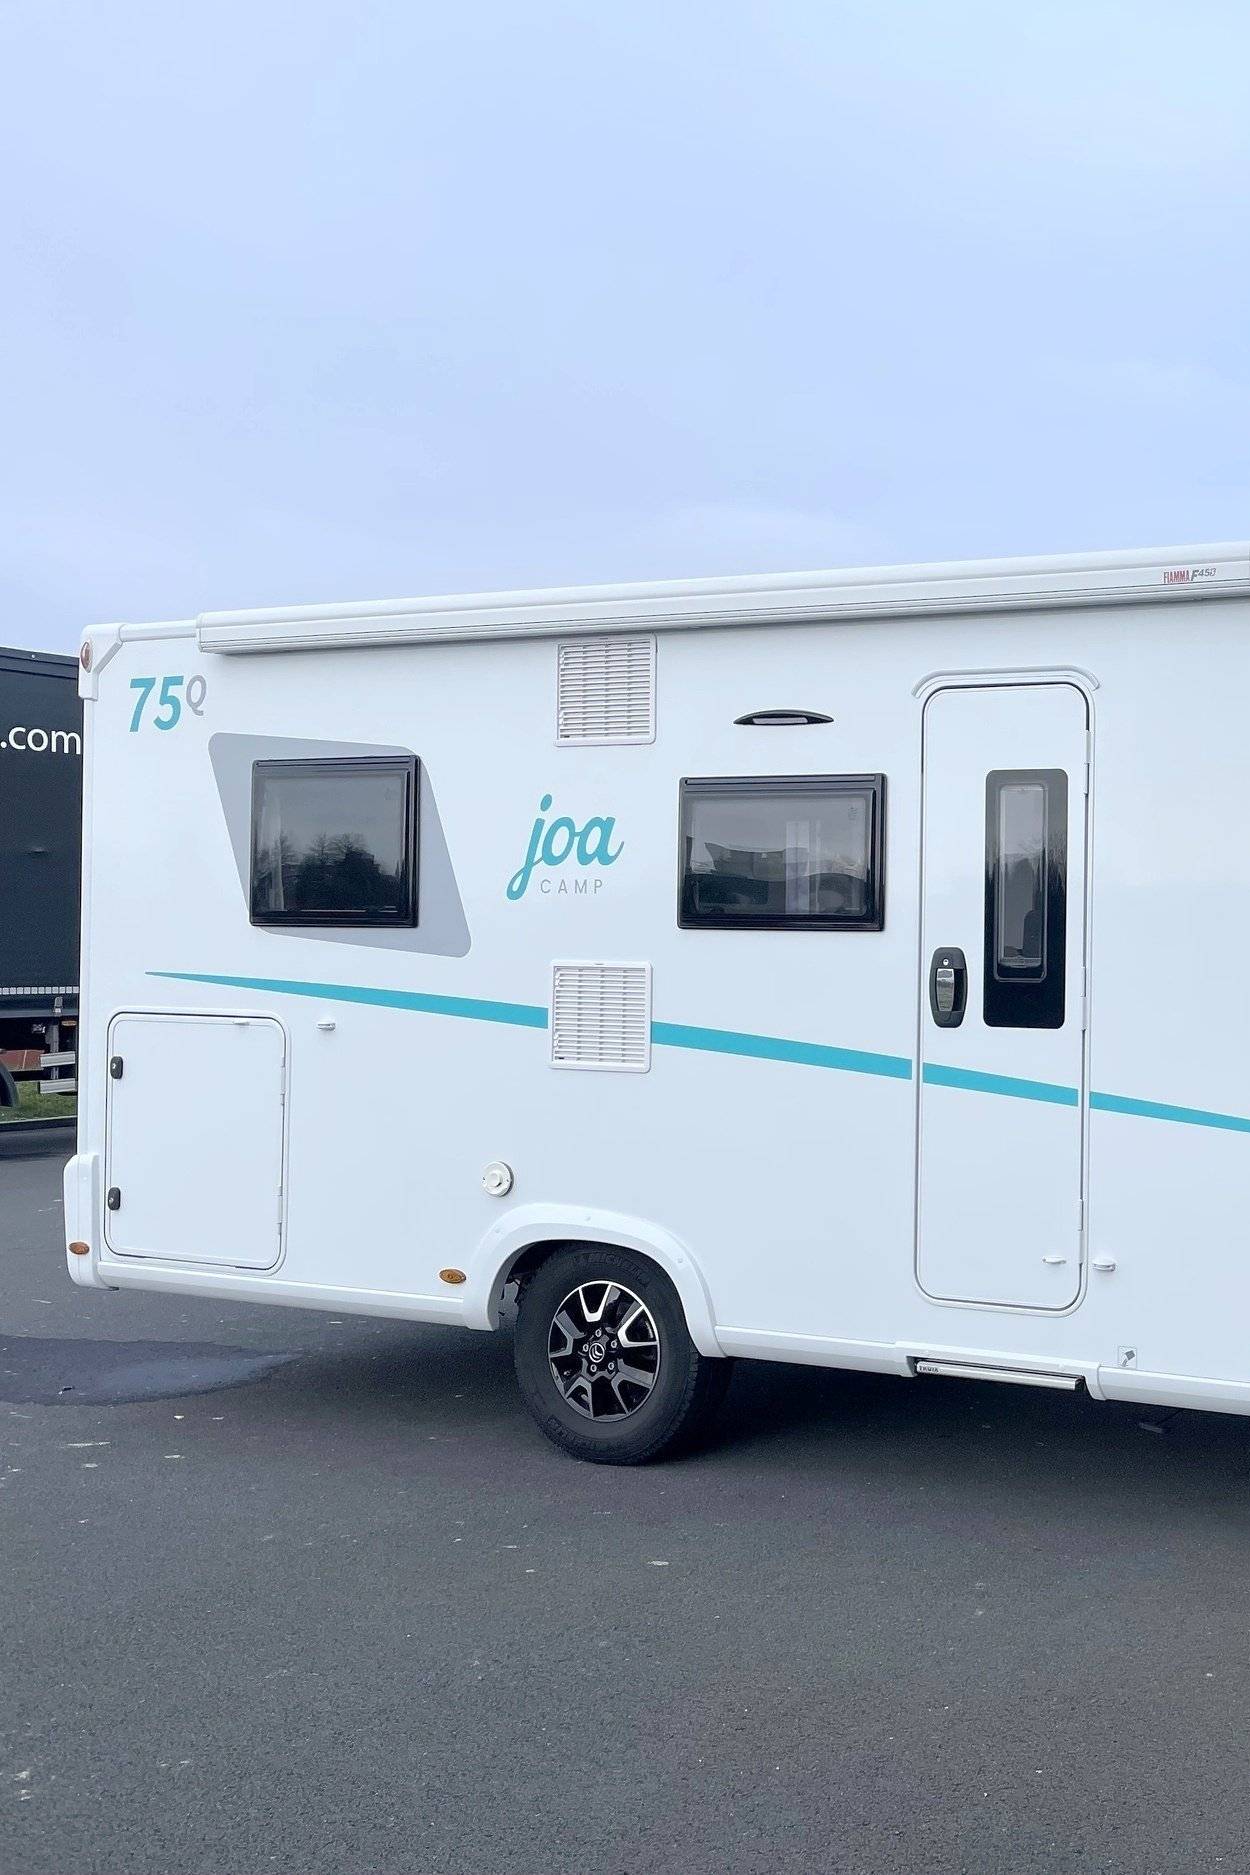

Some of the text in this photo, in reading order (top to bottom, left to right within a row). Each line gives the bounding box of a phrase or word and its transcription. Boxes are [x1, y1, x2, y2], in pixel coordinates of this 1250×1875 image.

[1163, 570, 1190, 584] FIAMMA
[506, 793, 625, 901] joa
[540, 878, 603, 895] CAMP
